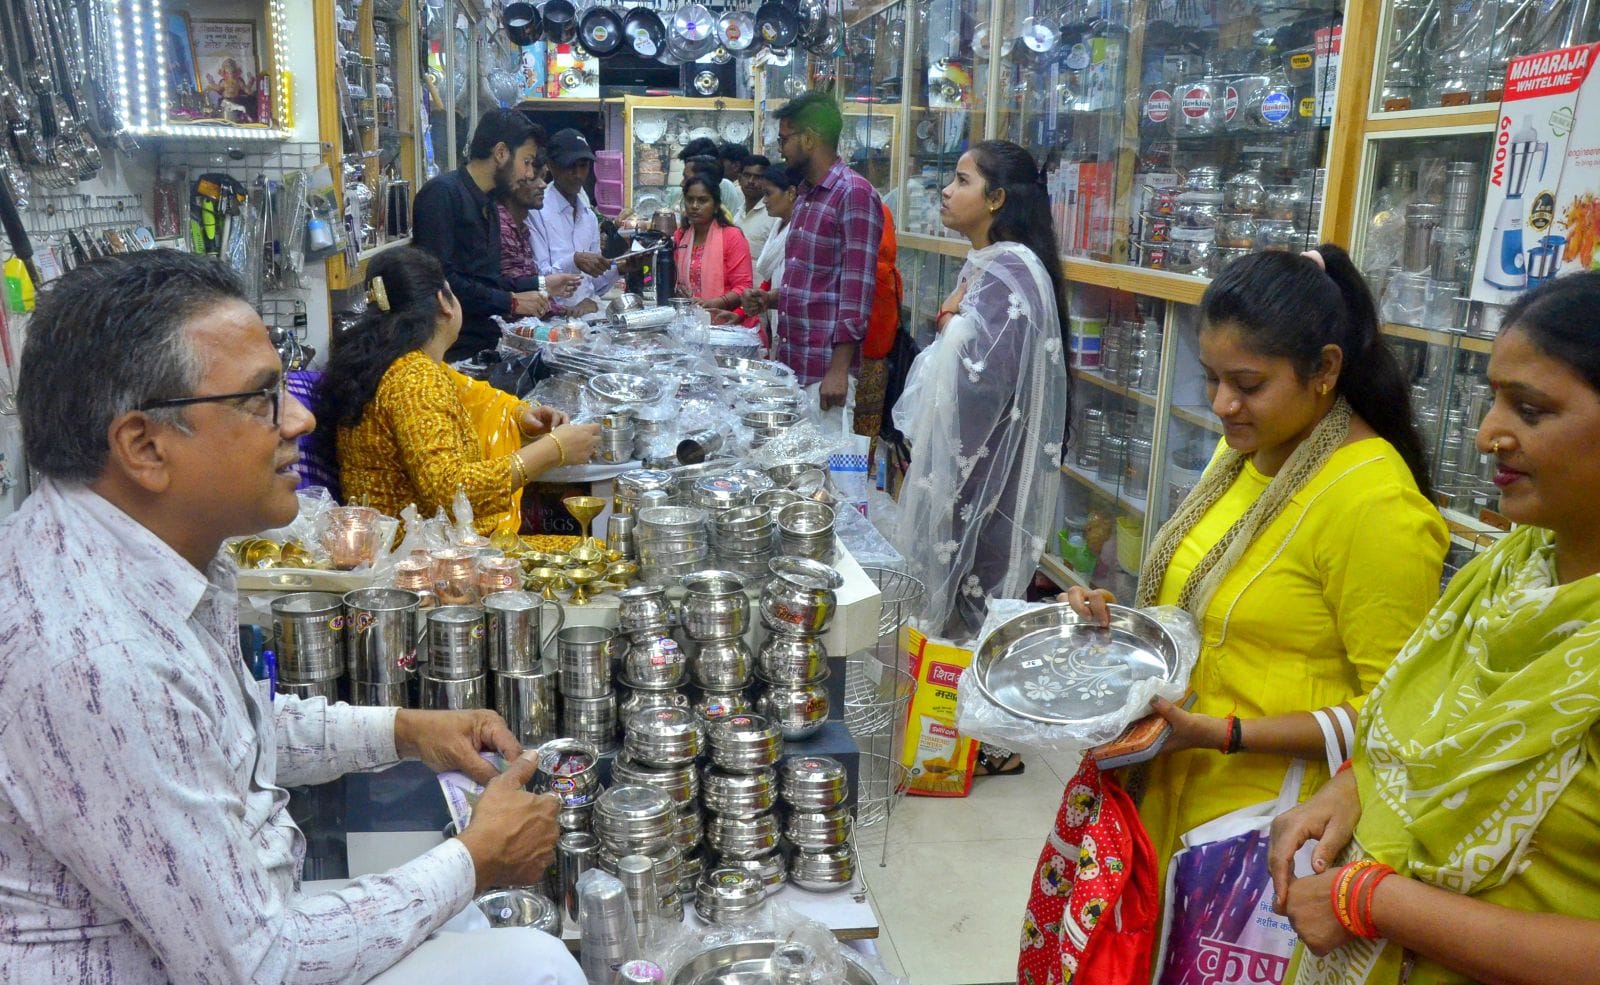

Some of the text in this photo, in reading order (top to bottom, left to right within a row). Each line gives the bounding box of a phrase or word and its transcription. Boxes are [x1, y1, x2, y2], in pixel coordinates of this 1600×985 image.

[1509, 49, 1588, 80] MAHARAJA
[1516, 73, 1573, 93] WHITELINE
[1262, 104, 1290, 112] Hawkins
[1491, 115, 1512, 187] 600W
[1567, 148, 1600, 160] engineere
[934, 688, 957, 702] मसा
[1256, 916, 1278, 929] मशीन
